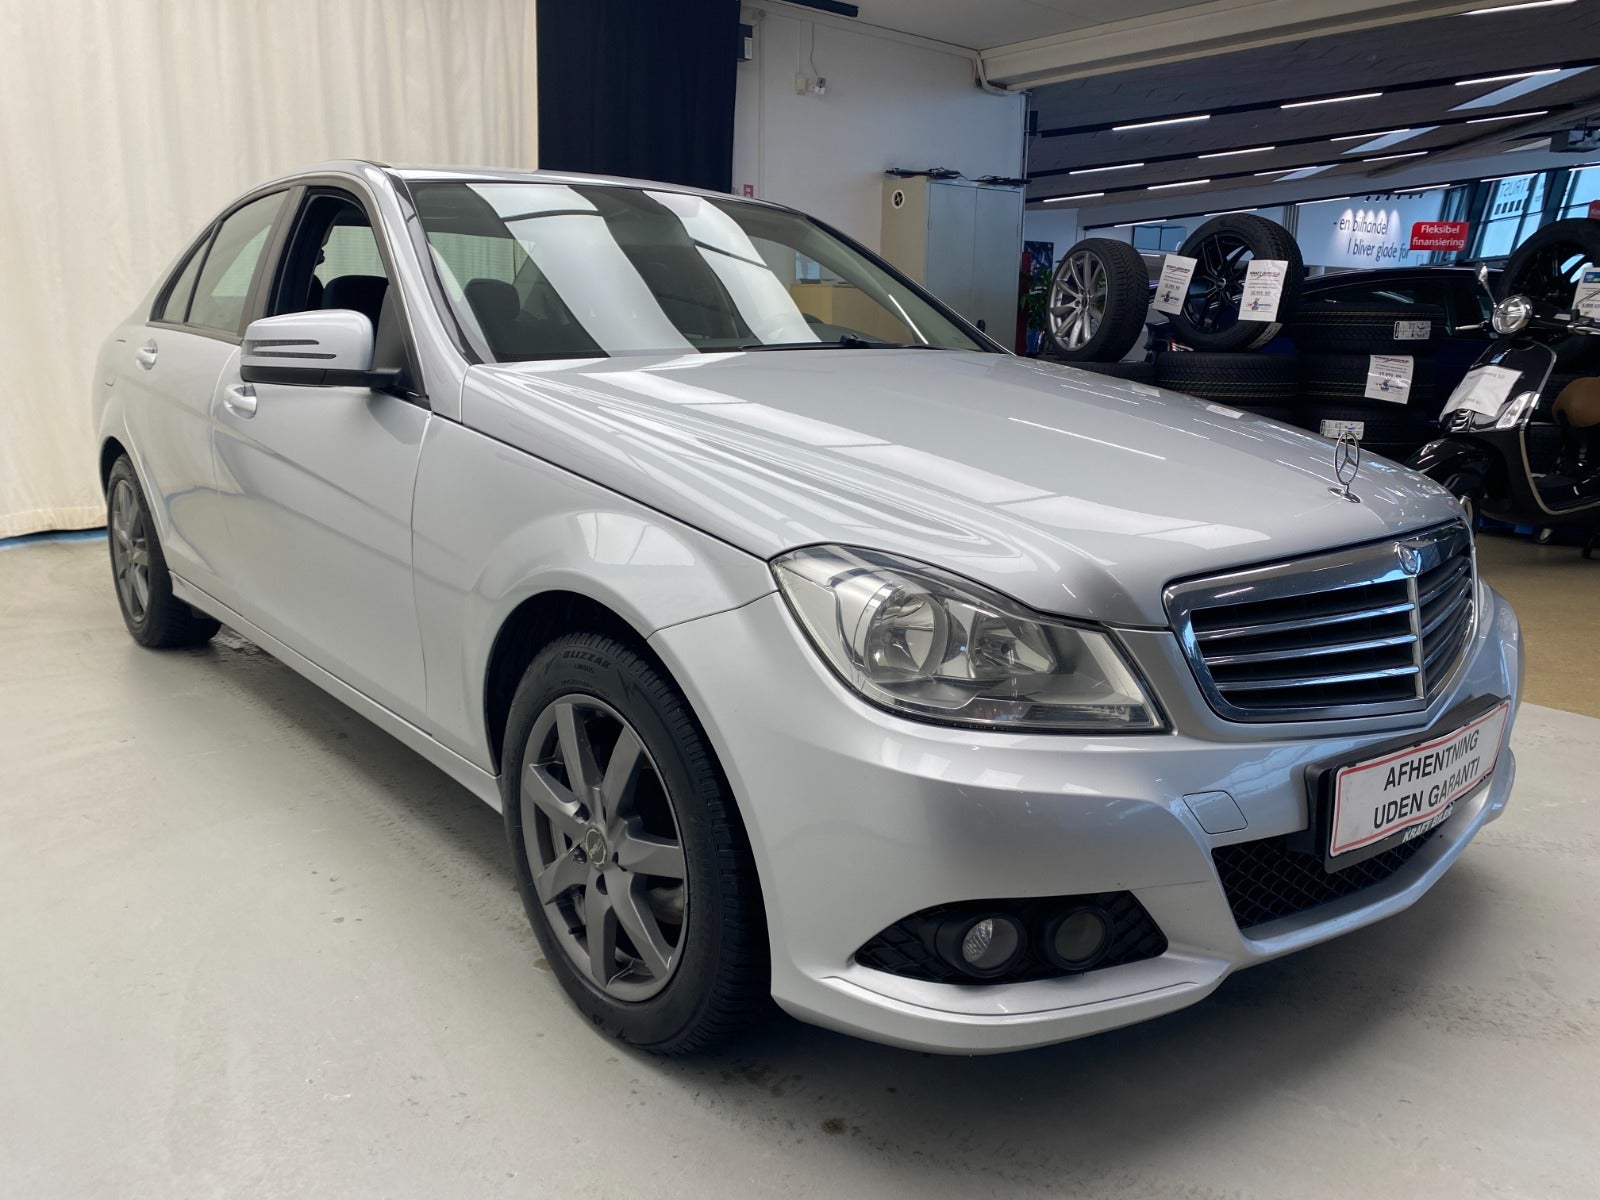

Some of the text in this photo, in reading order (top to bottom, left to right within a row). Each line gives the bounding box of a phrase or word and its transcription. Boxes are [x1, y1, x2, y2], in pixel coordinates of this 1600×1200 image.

[1340, 218, 1350, 230] en
[1353, 216, 1389, 235] bilhandel
[1421, 224, 1460, 234] Fleksibel
[1353, 240, 1375, 256] bliver
[1376, 242, 1397, 261] glade
[1412, 237, 1464, 248] finansiering
[562, 650, 611, 668] BLIZZAK
[1384, 729, 1479, 791] AFHENTNING
[1374, 756, 1480, 829] UDEN GARANTI
